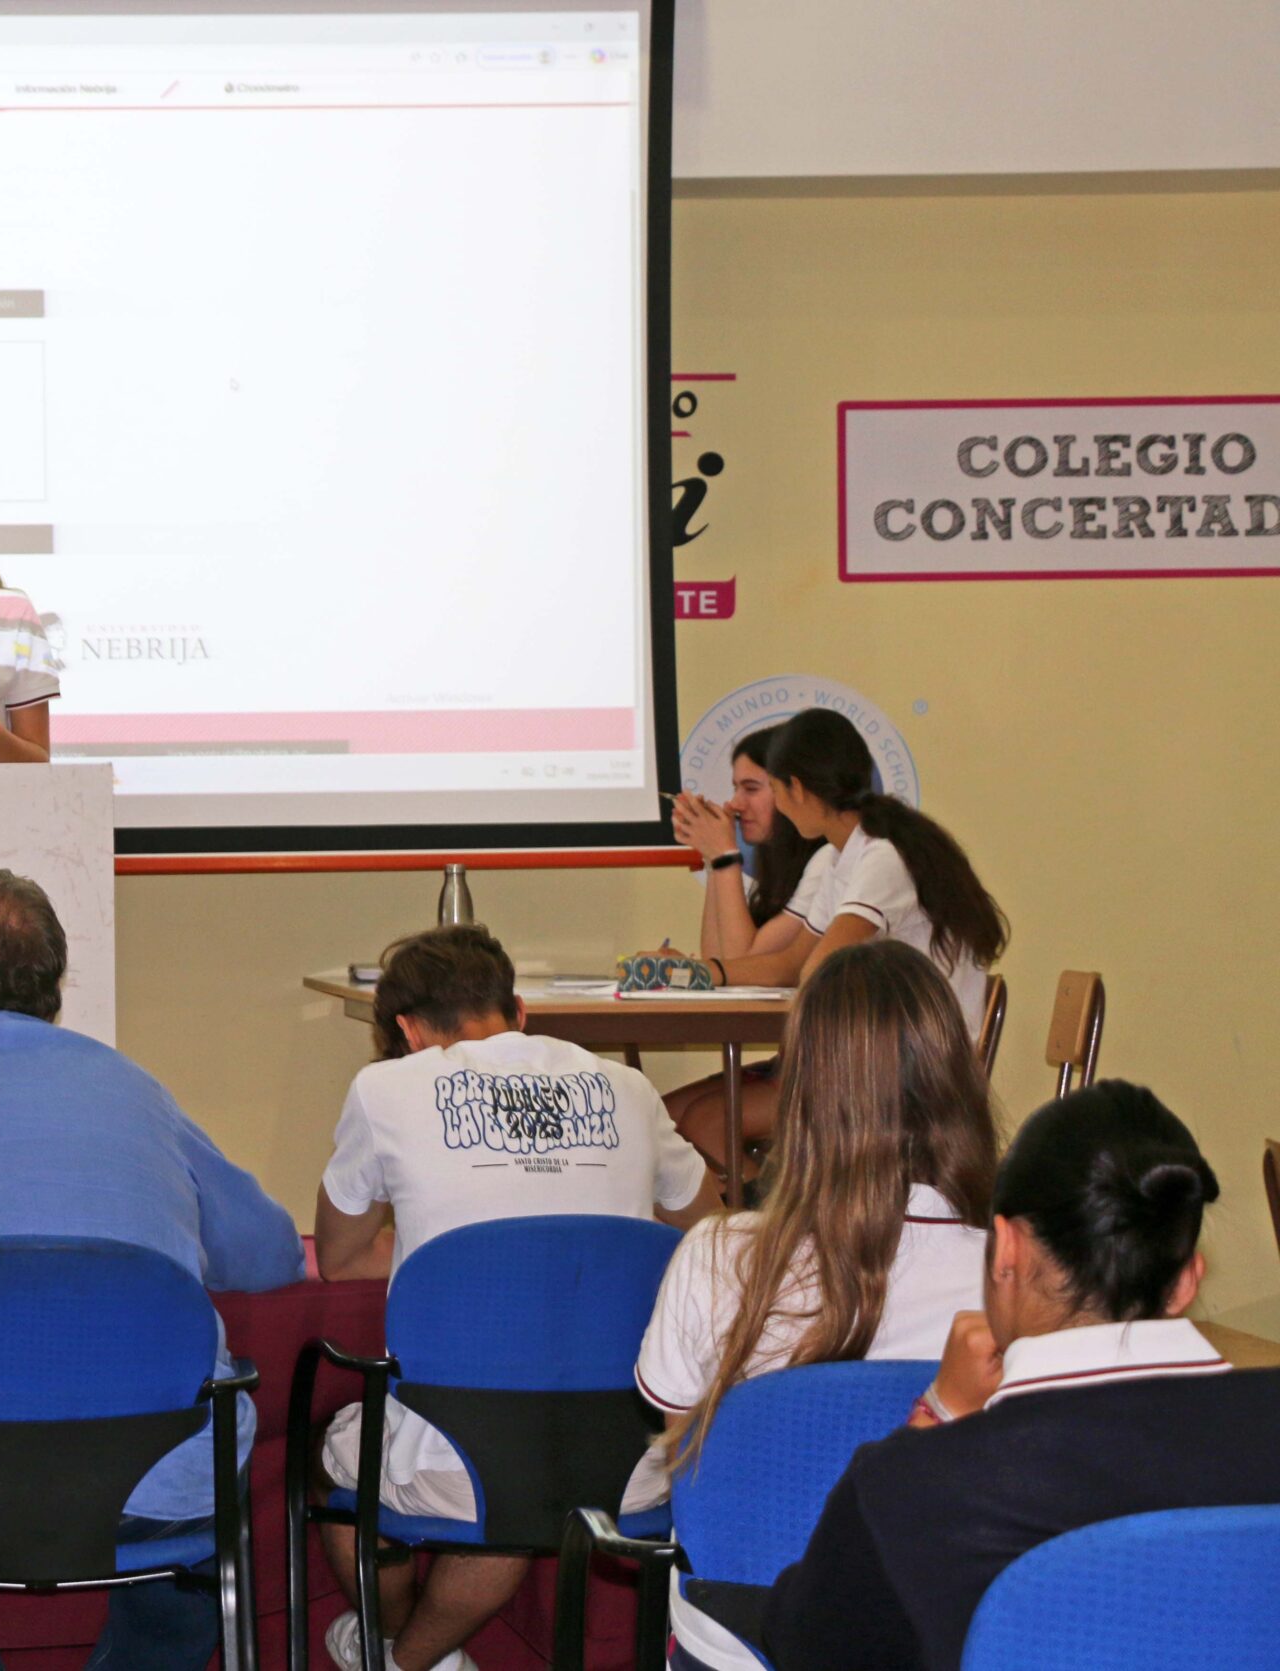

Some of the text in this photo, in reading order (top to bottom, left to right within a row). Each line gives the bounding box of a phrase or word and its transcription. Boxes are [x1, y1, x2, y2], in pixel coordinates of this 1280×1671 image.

[956, 432, 1257, 478] COLEGIO
[81, 637, 210, 666] NEBRIJA
[688, 736, 714, 770] DEL
[716, 687, 790, 733] MUNDO
[815, 689, 880, 735] WORLD
